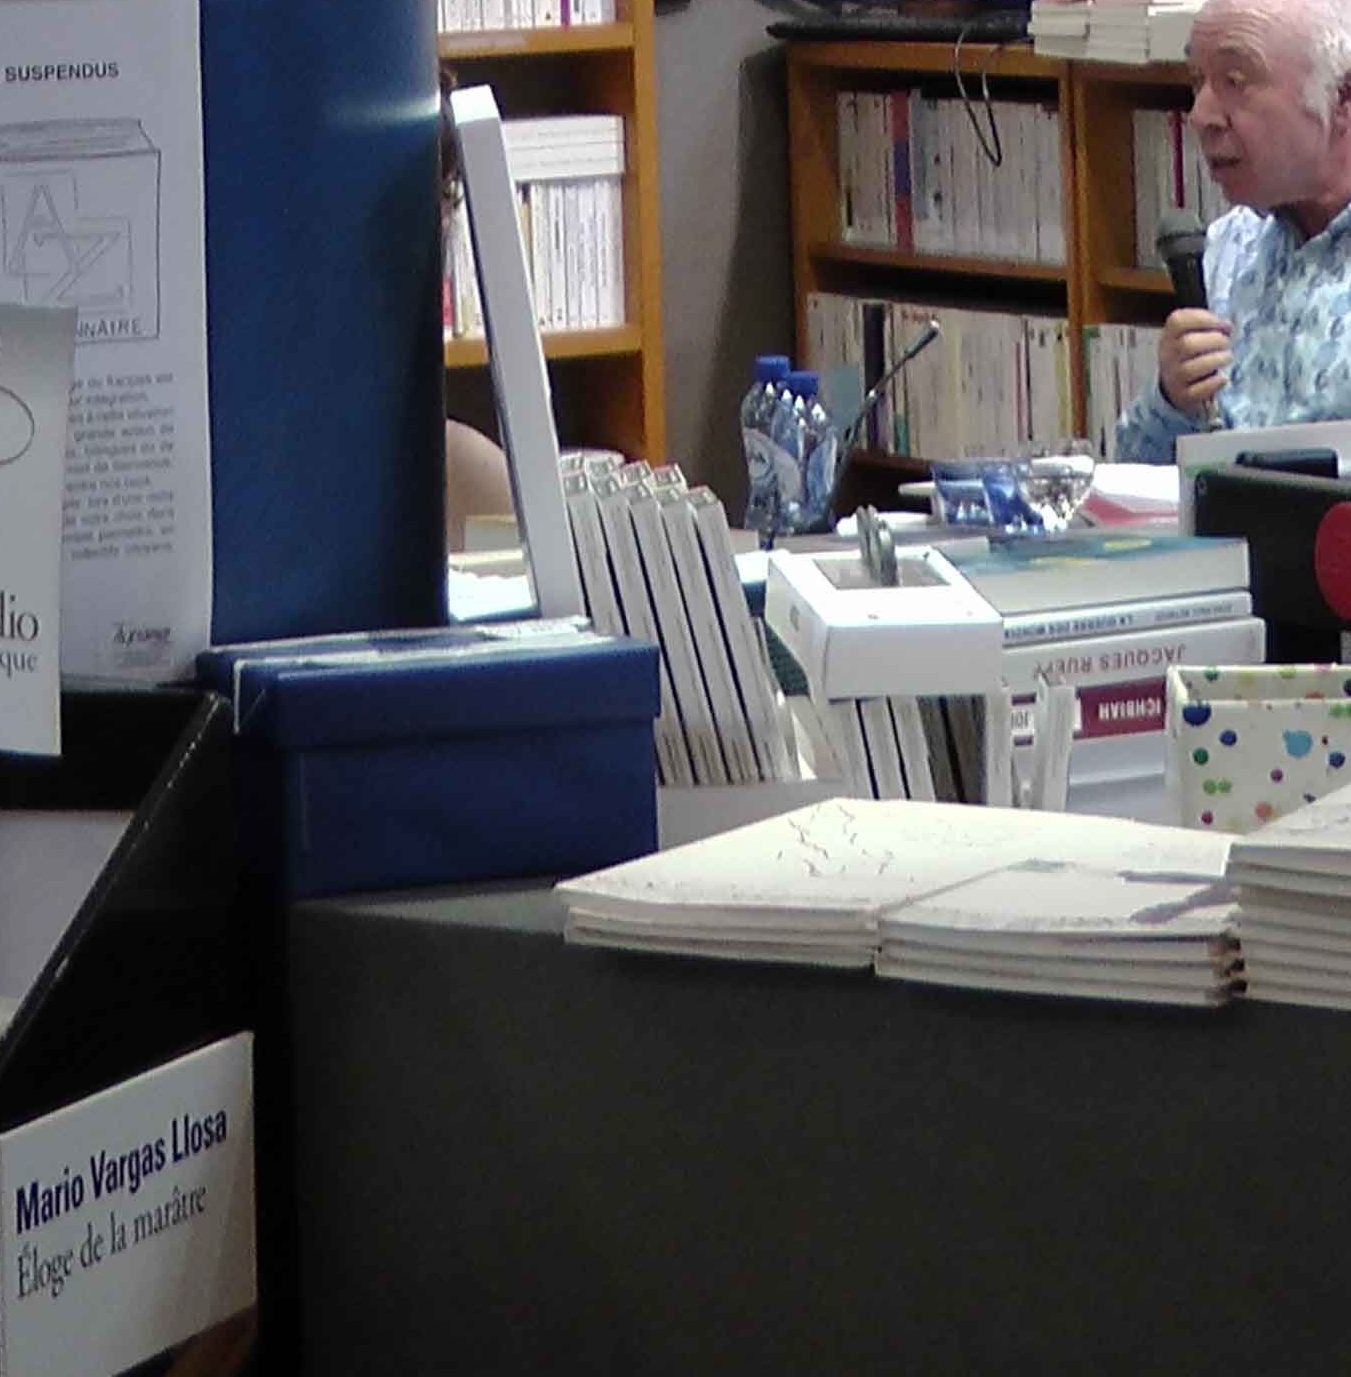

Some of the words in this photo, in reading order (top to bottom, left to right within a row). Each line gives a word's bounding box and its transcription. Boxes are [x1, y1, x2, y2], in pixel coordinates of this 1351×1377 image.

[5, 61, 120, 83] SUSPENDUS
[1099, 643, 1187, 665] JACQUES
[1099, 698, 1161, 722] ICHBIAH
[16, 1166, 85, 1235] Mario
[90, 1137, 166, 1199] Vargas
[171, 1110, 227, 1164] Llosa
[17, 1241, 74, 1299] Éloge
[79, 1222, 104, 1270] de
[110, 1210, 128, 1255] la
[133, 1184, 207, 1245] marâtre
